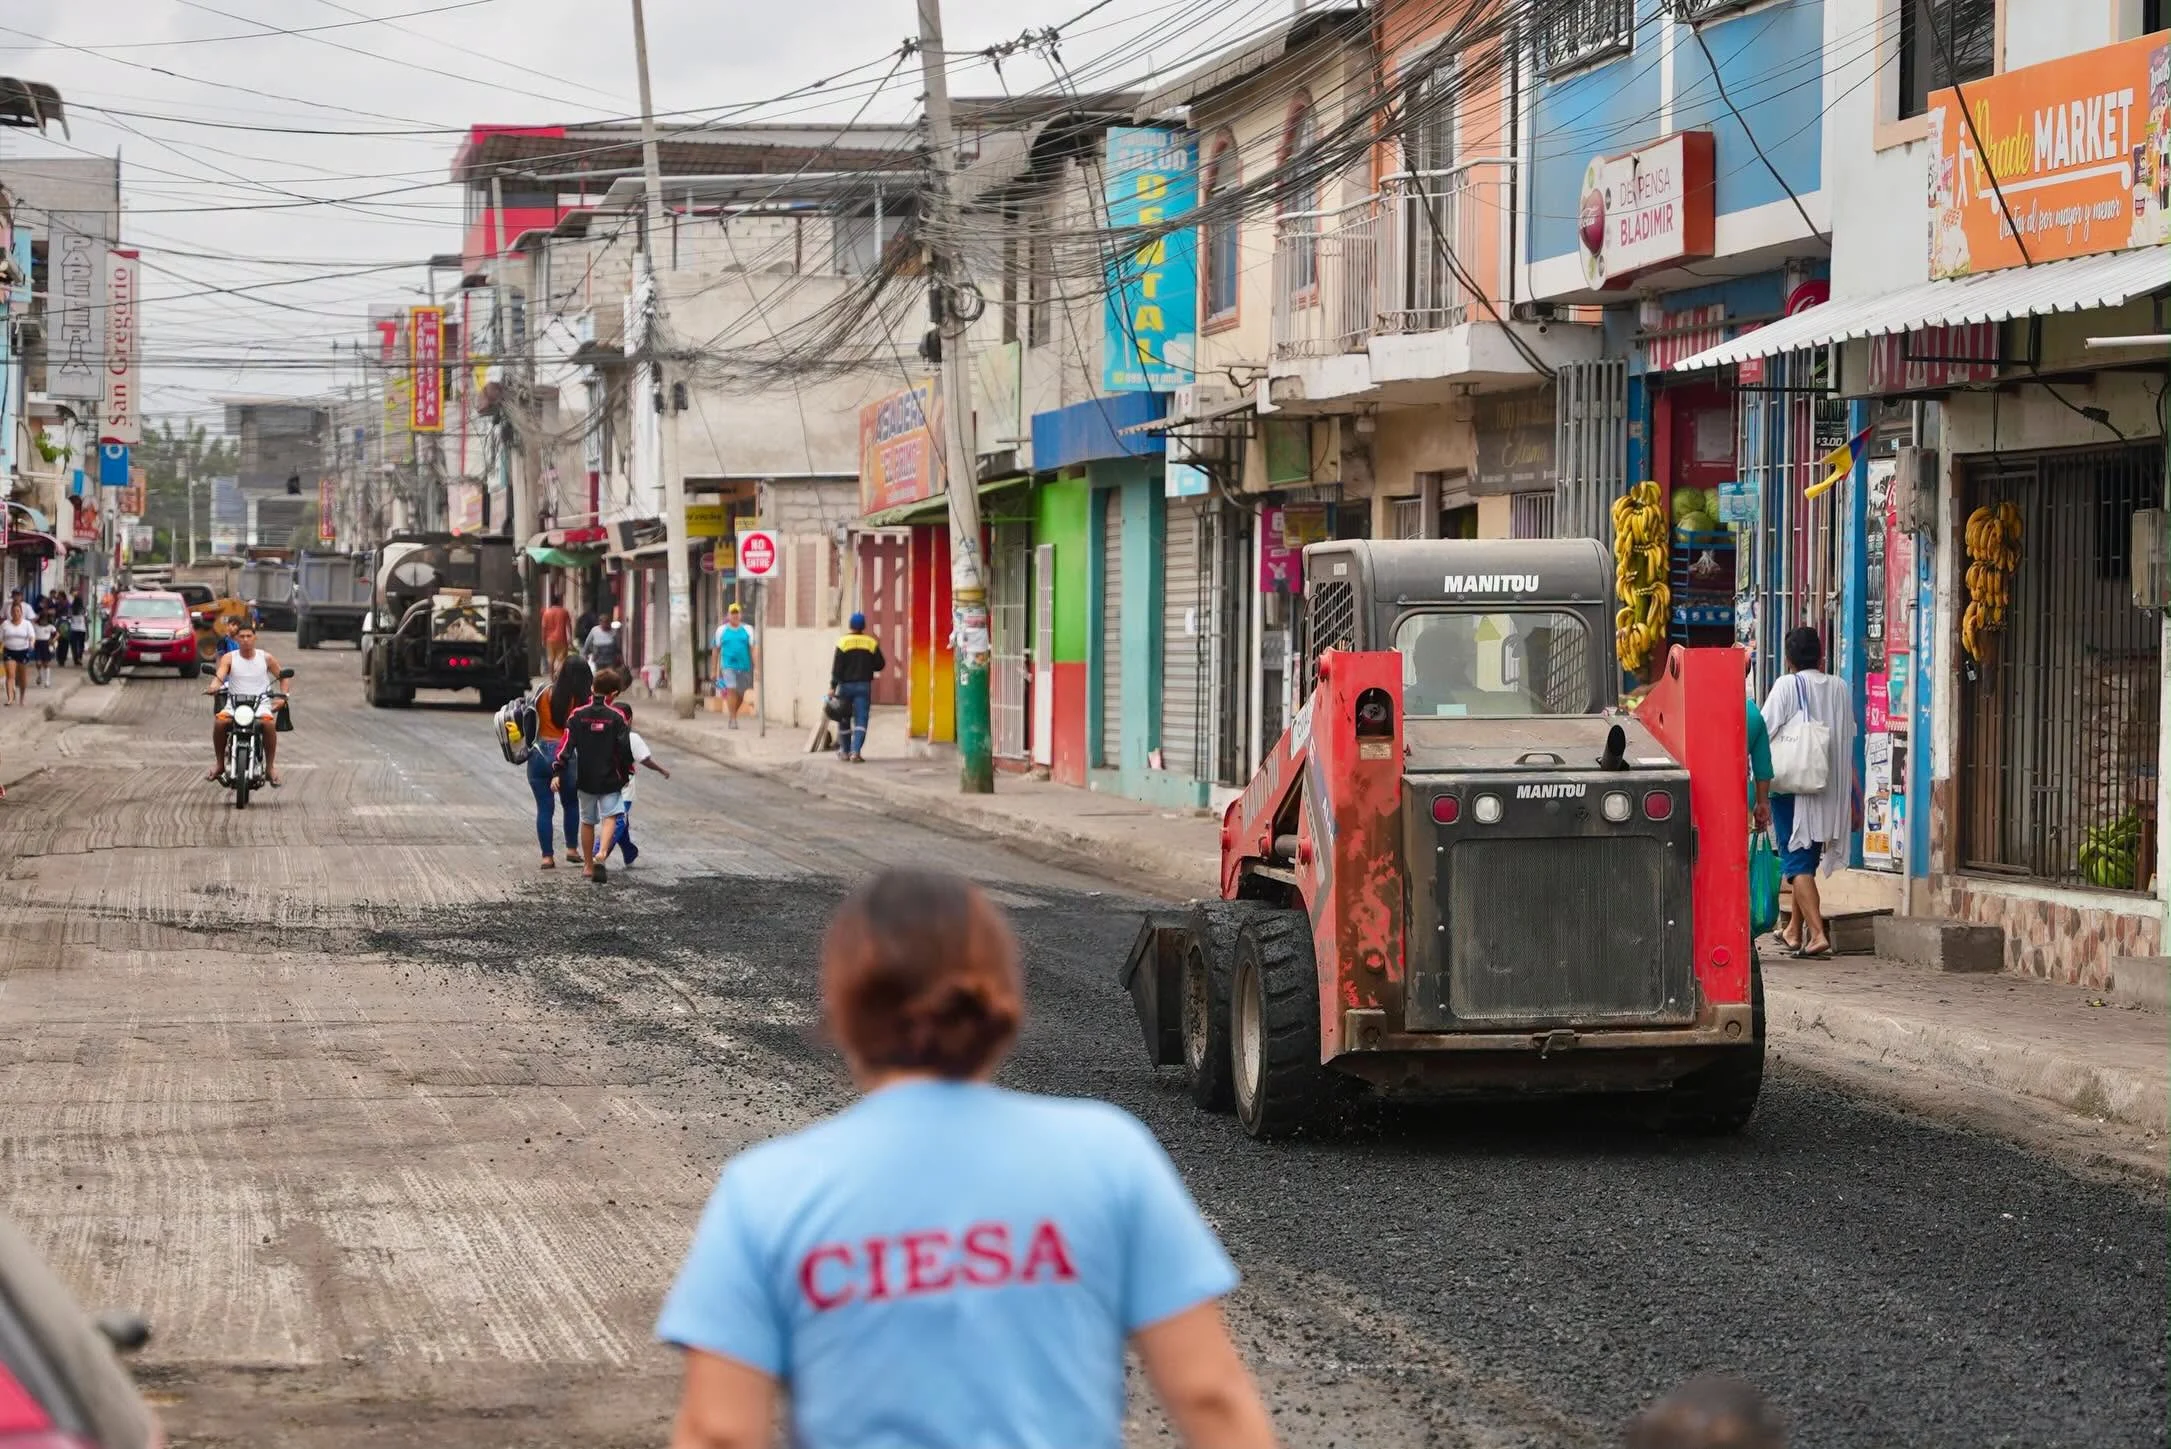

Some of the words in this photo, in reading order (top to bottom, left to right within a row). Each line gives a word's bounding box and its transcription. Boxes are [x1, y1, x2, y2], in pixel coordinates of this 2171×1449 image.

[2034, 88, 2133, 173] MARKET
[1620, 168, 1671, 207] DEPENSA
[1620, 203, 1674, 246] BLADIMIR
[2038, 208, 2054, 241] por
[2056, 203, 2083, 245] mayor
[2083, 203, 2091, 242] y
[2093, 196, 2122, 221] menor
[108, 267, 132, 376] Gregorio
[108, 384, 127, 426] San
[1816, 436, 1843, 448] $3.00
[746, 558, 770, 568] ENTRE
[750, 539, 765, 550] NO
[1444, 575, 1539, 593] MANITOU
[1516, 784, 1586, 799] MANITOU
[798, 1216, 1078, 1312] CIESA
